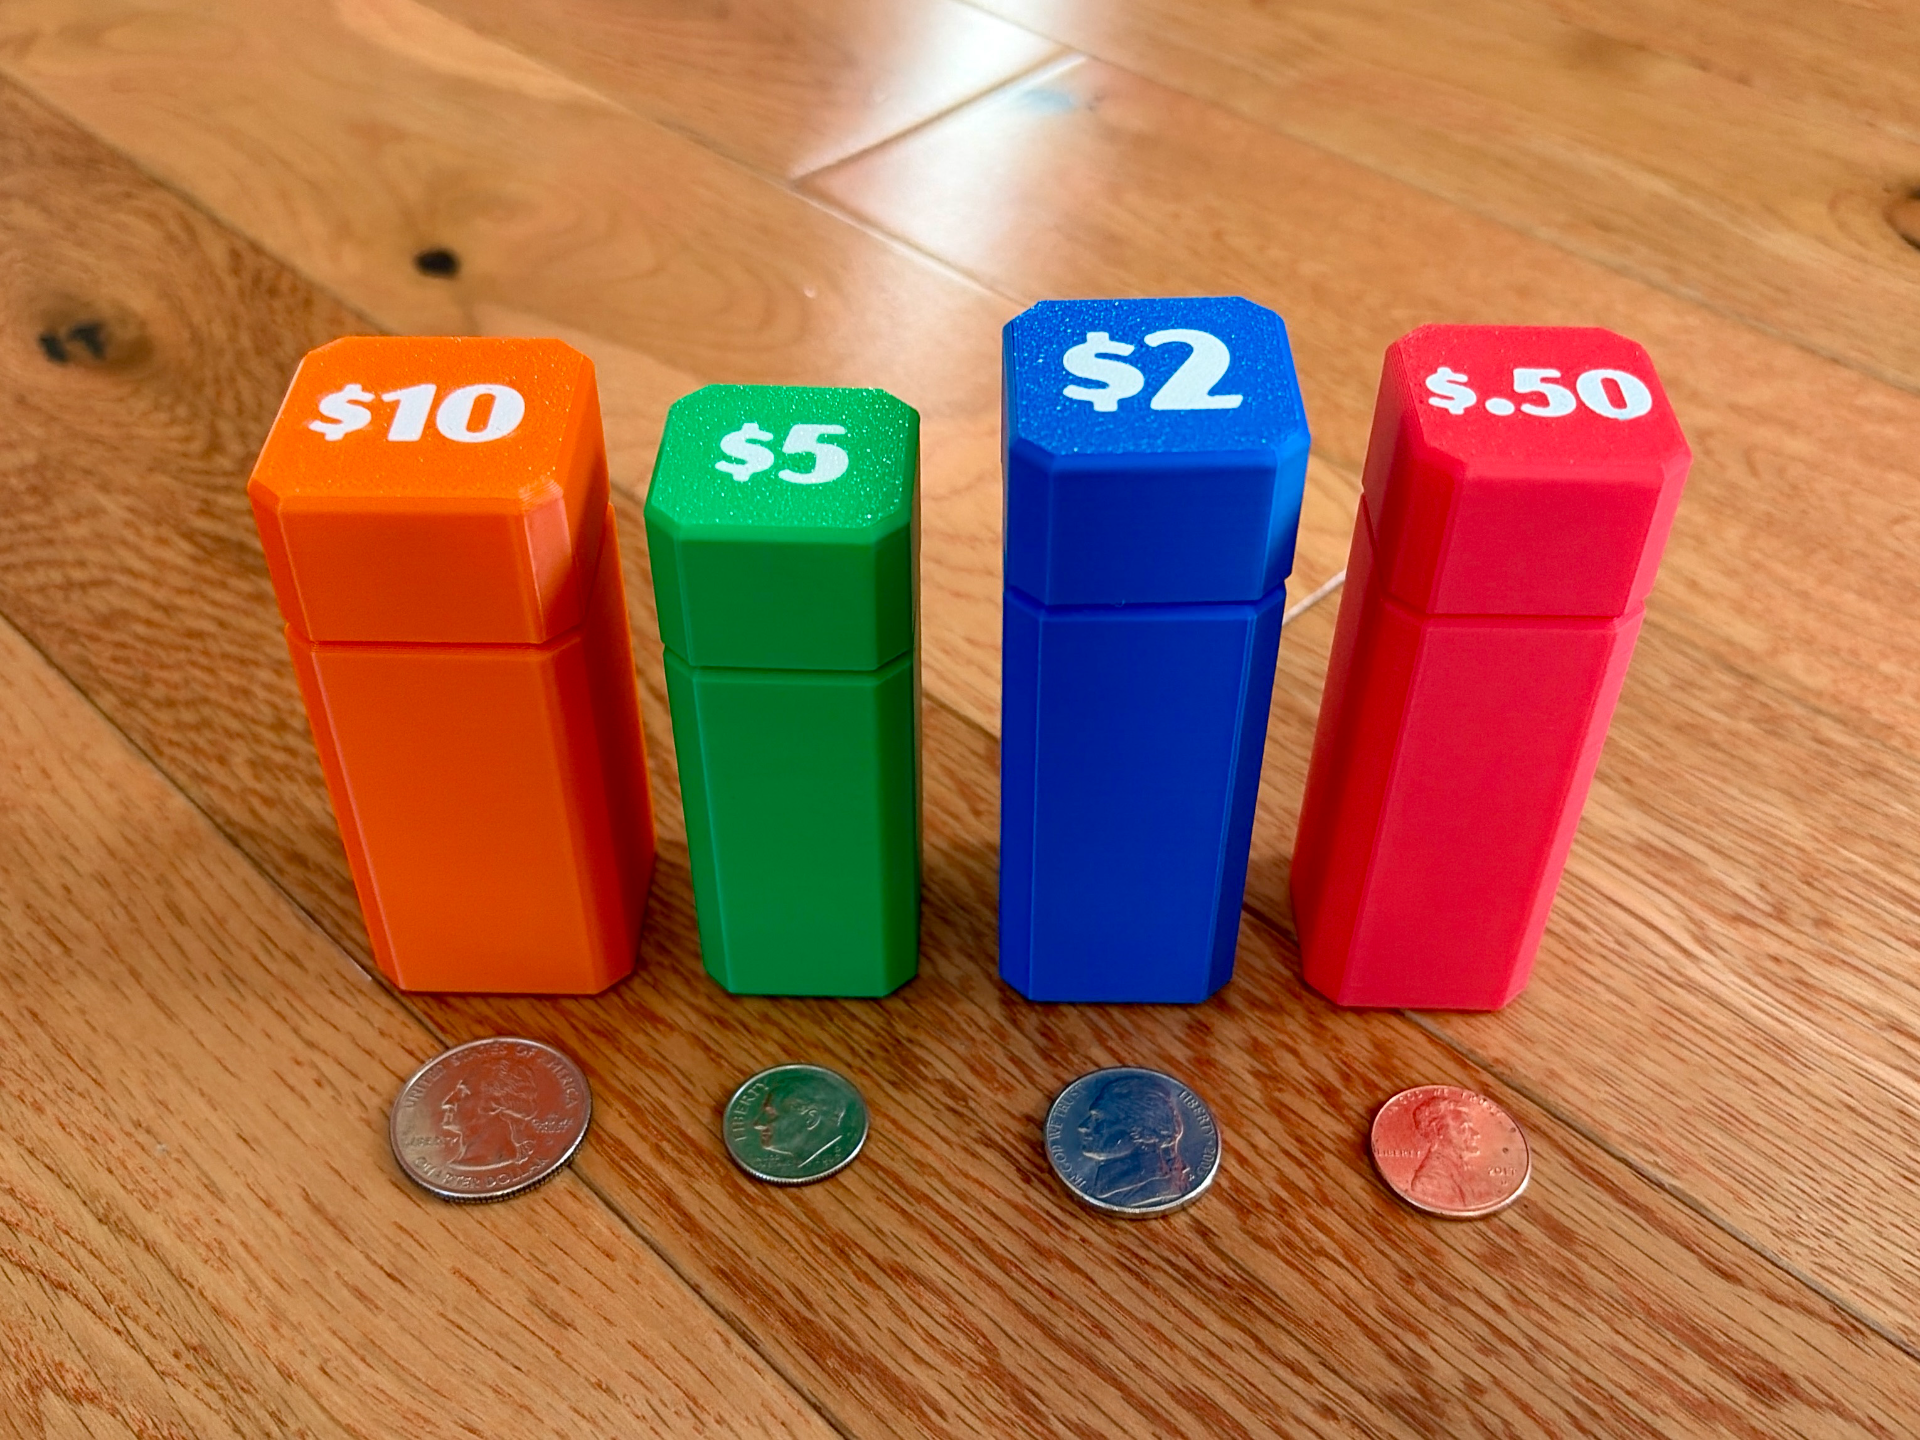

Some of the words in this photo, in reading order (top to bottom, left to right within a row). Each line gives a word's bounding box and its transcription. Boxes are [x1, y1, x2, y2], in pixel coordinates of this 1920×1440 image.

[1062, 328, 1244, 412] $2
[1425, 367, 1653, 420] $.50
[308, 383, 526, 443] $10
[714, 422, 849, 485] $5
[732, 1082, 769, 1142] LIBERTY
[1048, 1121, 1062, 1140] WE
[1178, 1089, 1216, 1138] LIBERTY
[1052, 1147, 1073, 1174] GOD
